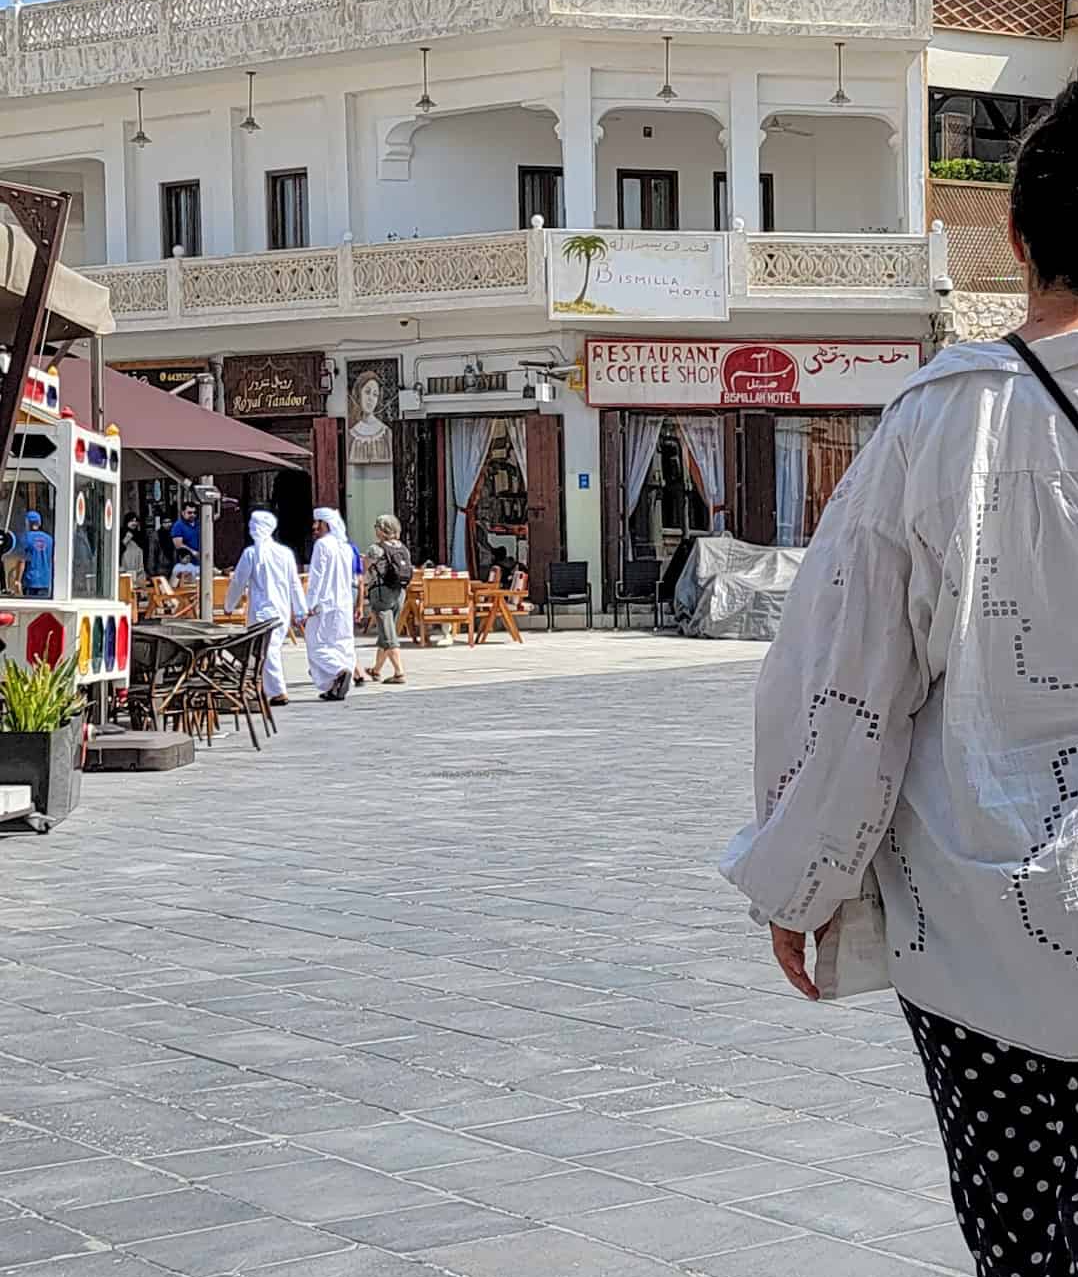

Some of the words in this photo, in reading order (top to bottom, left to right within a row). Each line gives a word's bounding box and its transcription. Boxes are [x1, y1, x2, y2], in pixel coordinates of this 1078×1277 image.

[594, 262, 679, 285] BISMILLA
[668, 288, 720, 298] HOTEL
[592, 345, 720, 364] RESTAURANT
[853, 347, 909, 375] مطعم
[606, 364, 671, 384] COFFEE
[679, 365, 719, 384] SHOP
[233, 394, 262, 413] Royal
[265, 392, 308, 408] Tandoor
[724, 392, 765, 404] BISMILLAH
[767, 392, 796, 404] HOTEL
